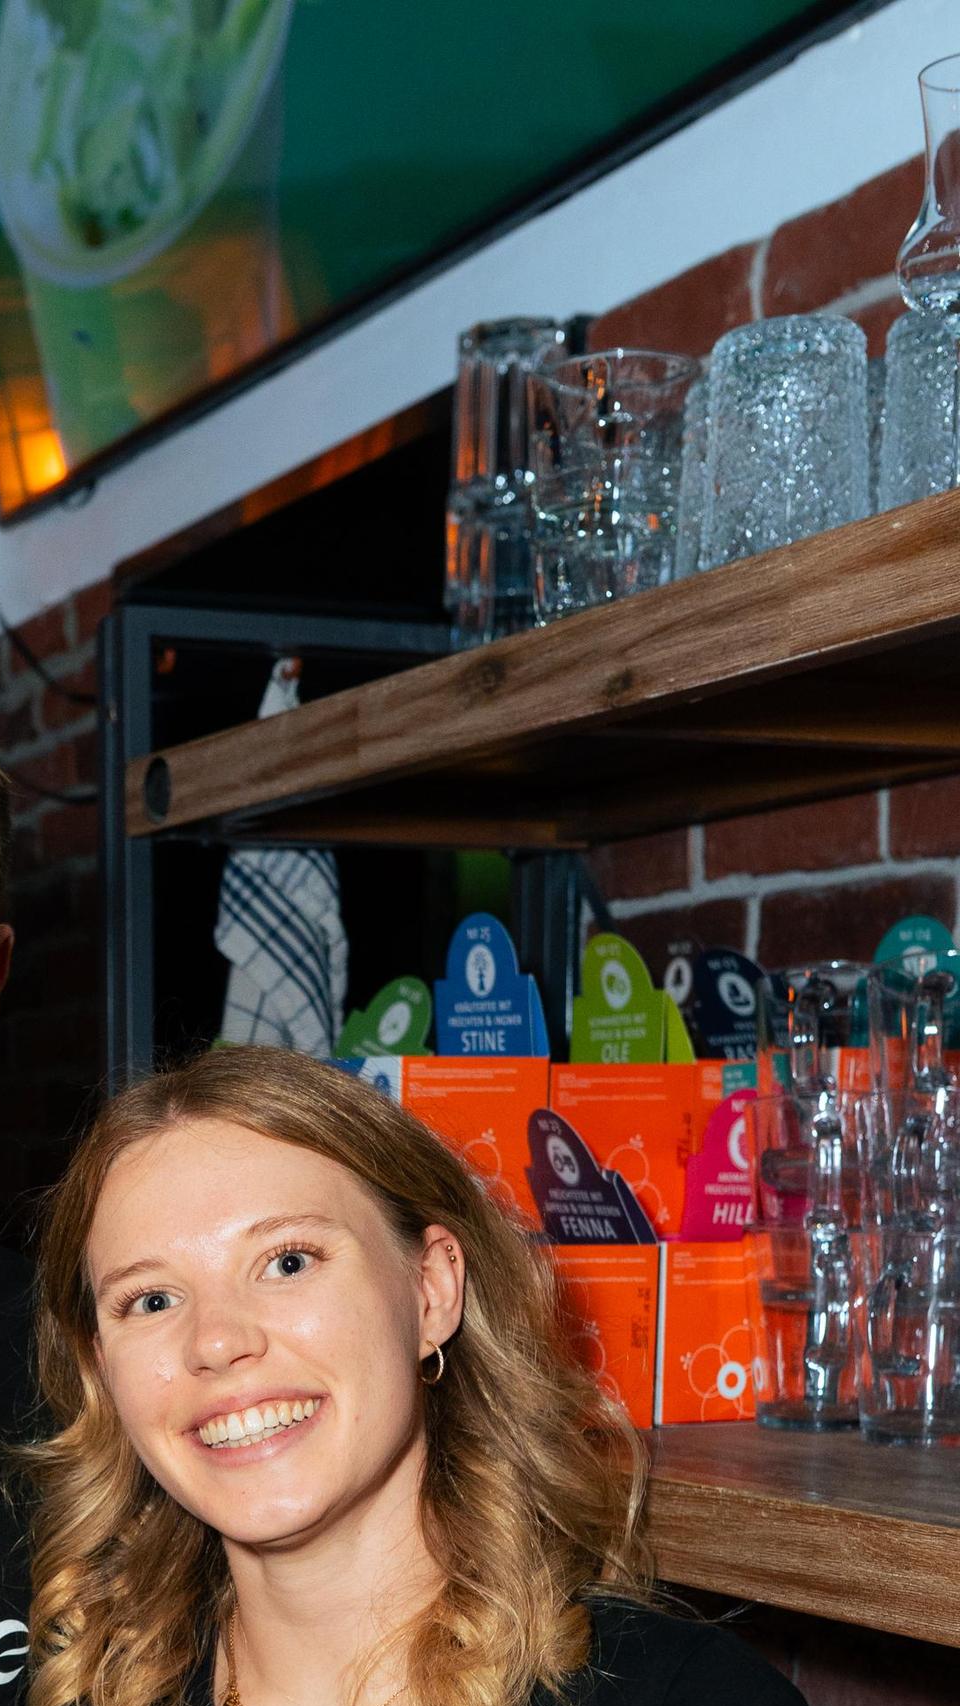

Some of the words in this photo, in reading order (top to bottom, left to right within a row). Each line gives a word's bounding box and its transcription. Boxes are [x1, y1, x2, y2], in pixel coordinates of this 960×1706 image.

[461, 1030, 507, 1053] STINE
[601, 1042, 631, 1064] OLE
[560, 1216, 618, 1239] FENNA
